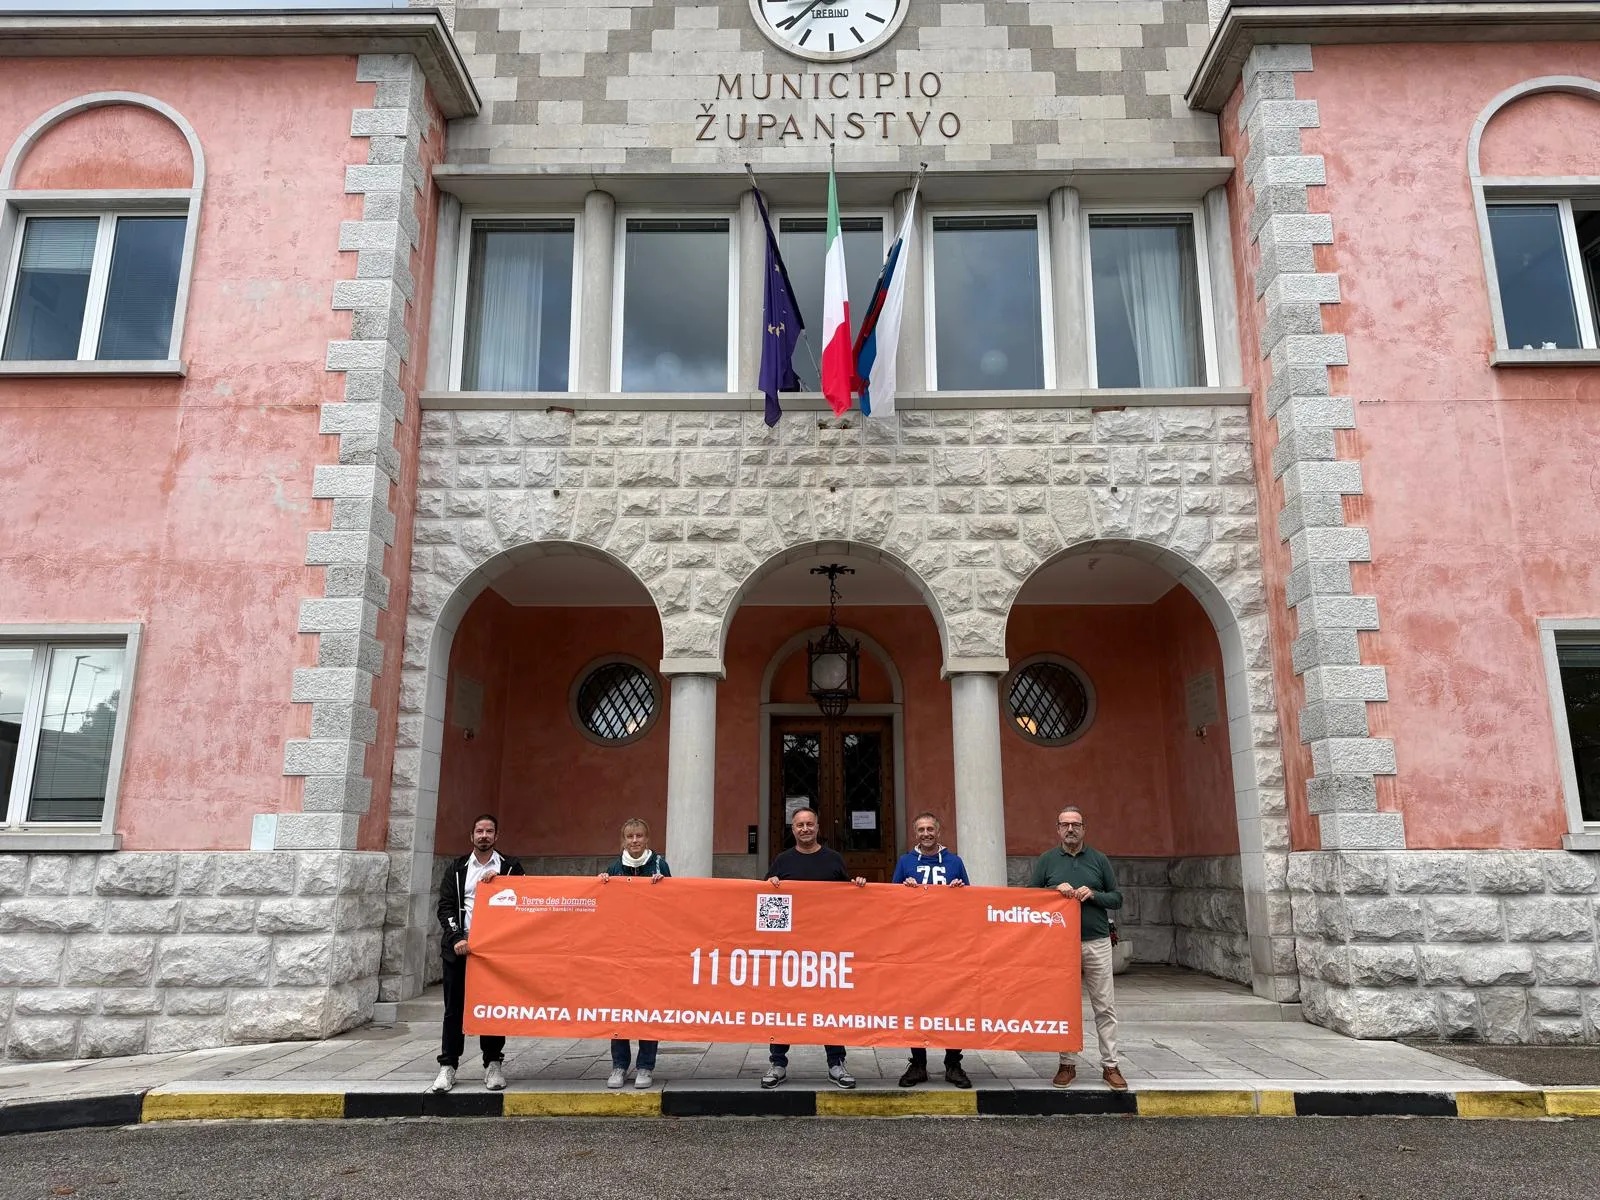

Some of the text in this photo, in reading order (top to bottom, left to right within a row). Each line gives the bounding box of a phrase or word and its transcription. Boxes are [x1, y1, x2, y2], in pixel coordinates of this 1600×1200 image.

[811, 9, 849, 18] TREBINO
[715, 71, 942, 100] MUNICIPIO
[695, 103, 961, 141] ŽUPANSTVO
[916, 866, 947, 885] 76
[521, 896, 597, 906] Terre des hommes
[690, 948, 855, 989] 11 OTTOBRE
[473, 1005, 1069, 1034] GIORNATA INTERNAZIONALE DELLE BAMBINE E DELLE RAGAZZE
